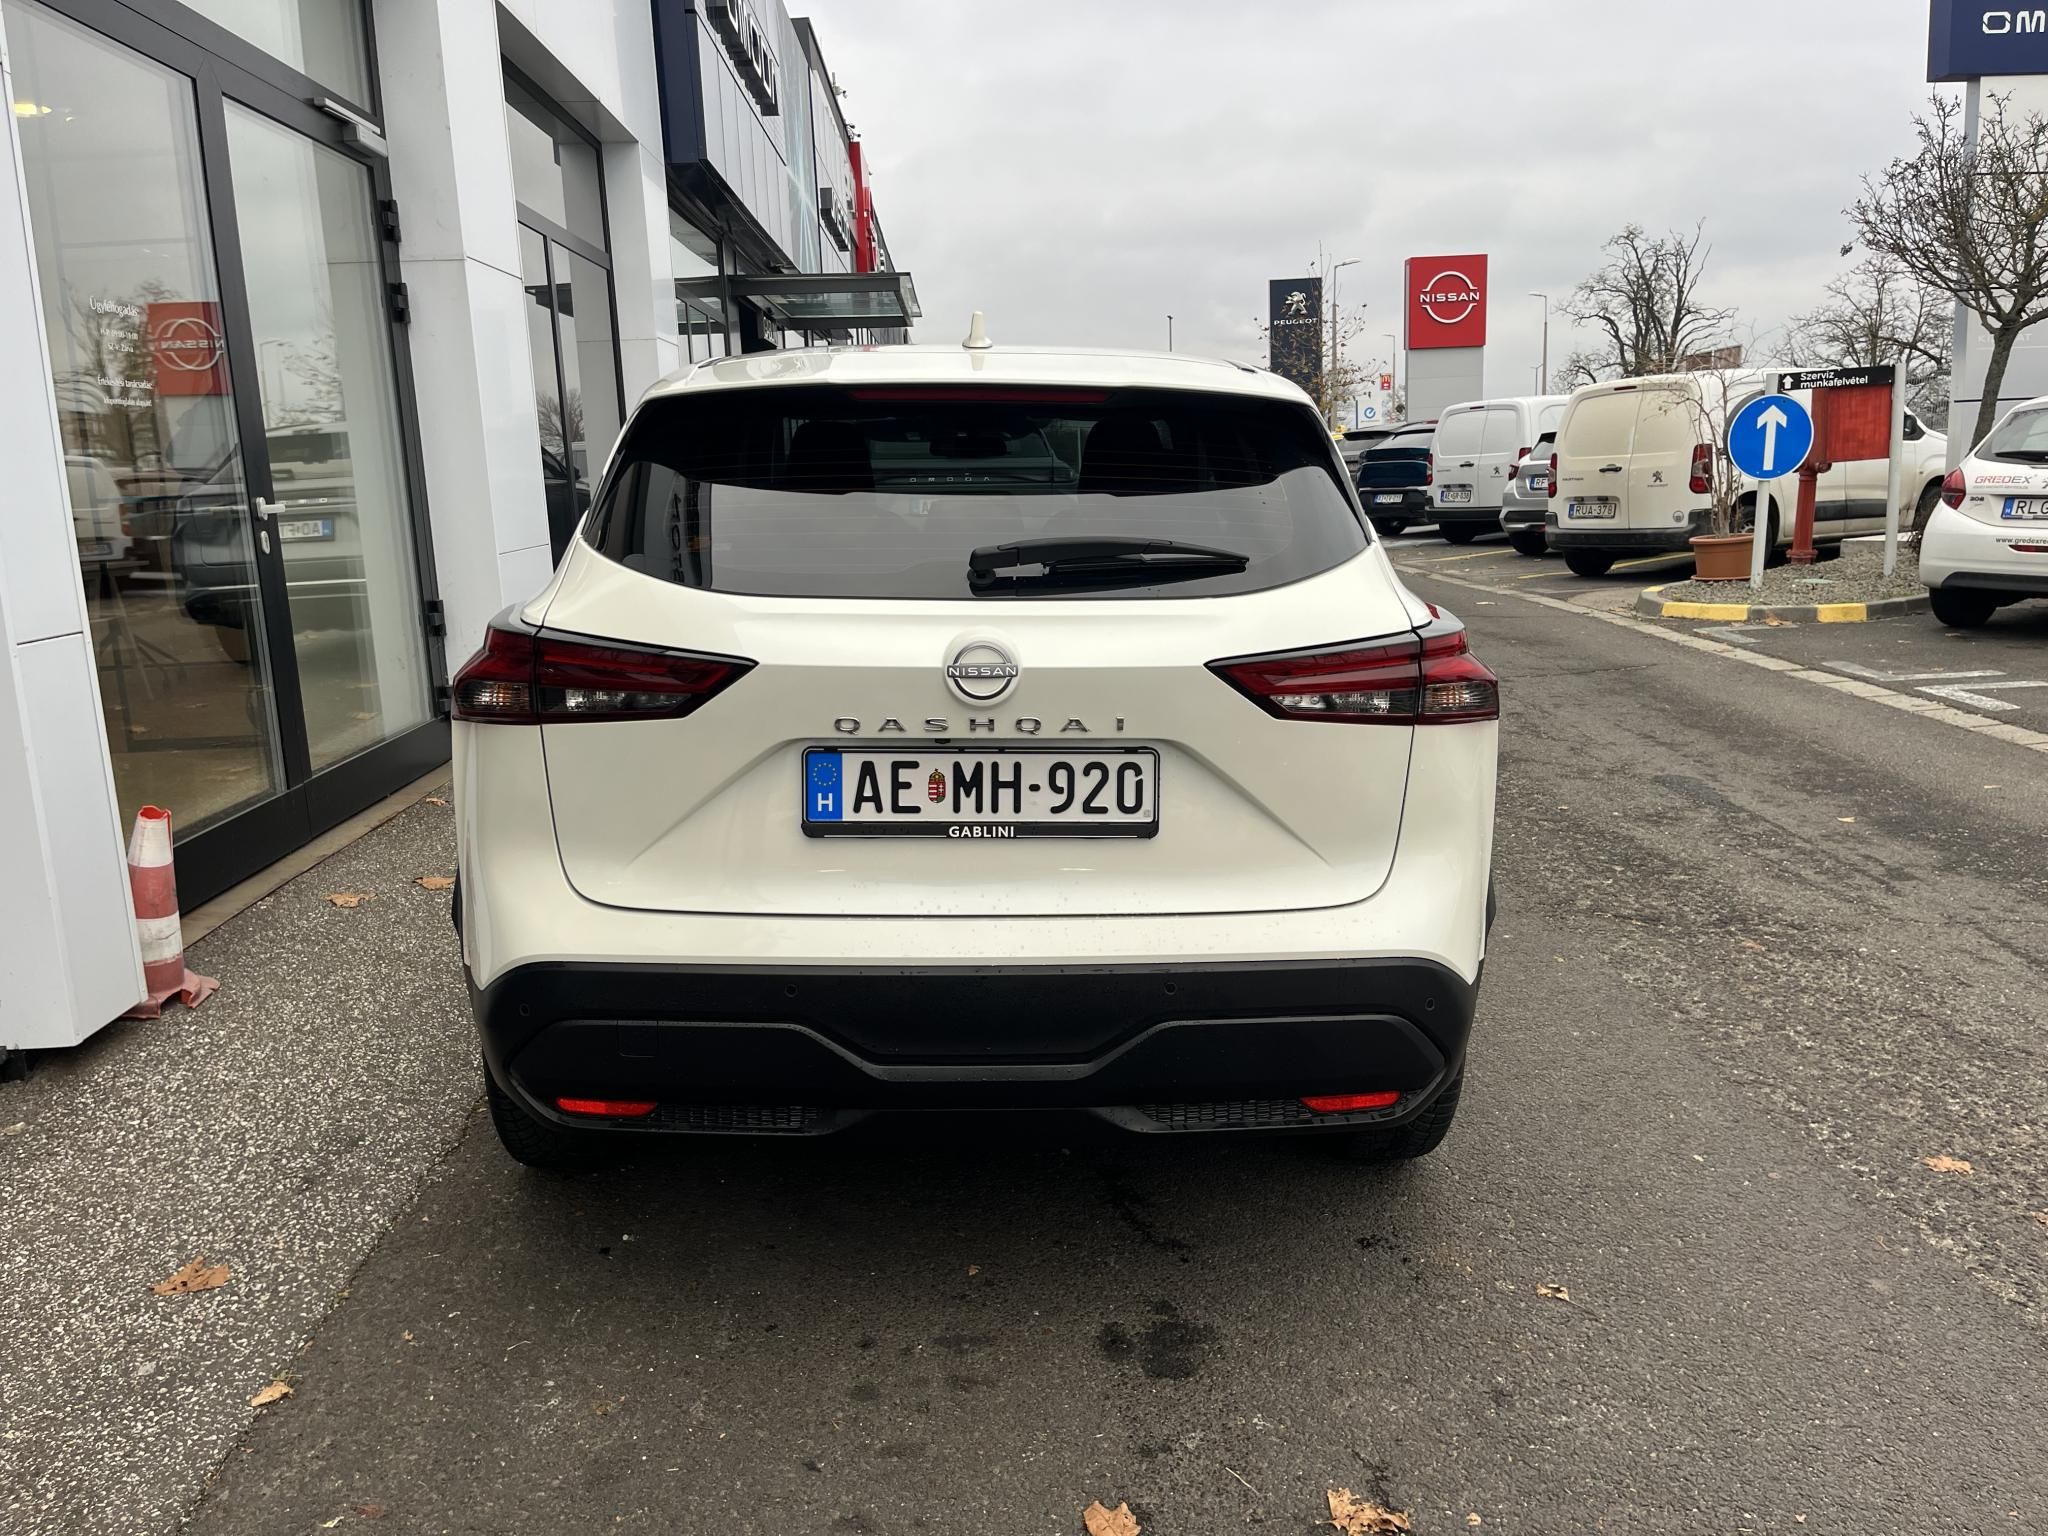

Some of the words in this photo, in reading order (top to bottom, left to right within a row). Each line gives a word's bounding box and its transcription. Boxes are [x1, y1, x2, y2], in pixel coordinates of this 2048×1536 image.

[1420, 290, 1480, 303] NISSAN
[1800, 370, 1835, 381] Szerviz
[1800, 375, 1868, 389] munkafelvétel
[1974, 475, 2032, 484] GREDEX
[1575, 504, 1612, 516] RUA-378
[2015, 500, 2048, 515] RLG
[948, 665, 1018, 678] NISSAN
[834, 716, 1126, 734] QASHQAI
[852, 760, 922, 814] AE
[952, 760, 1145, 815] MH-920
[817, 792, 833, 812] H
[948, 825, 1016, 838] GABLINI
